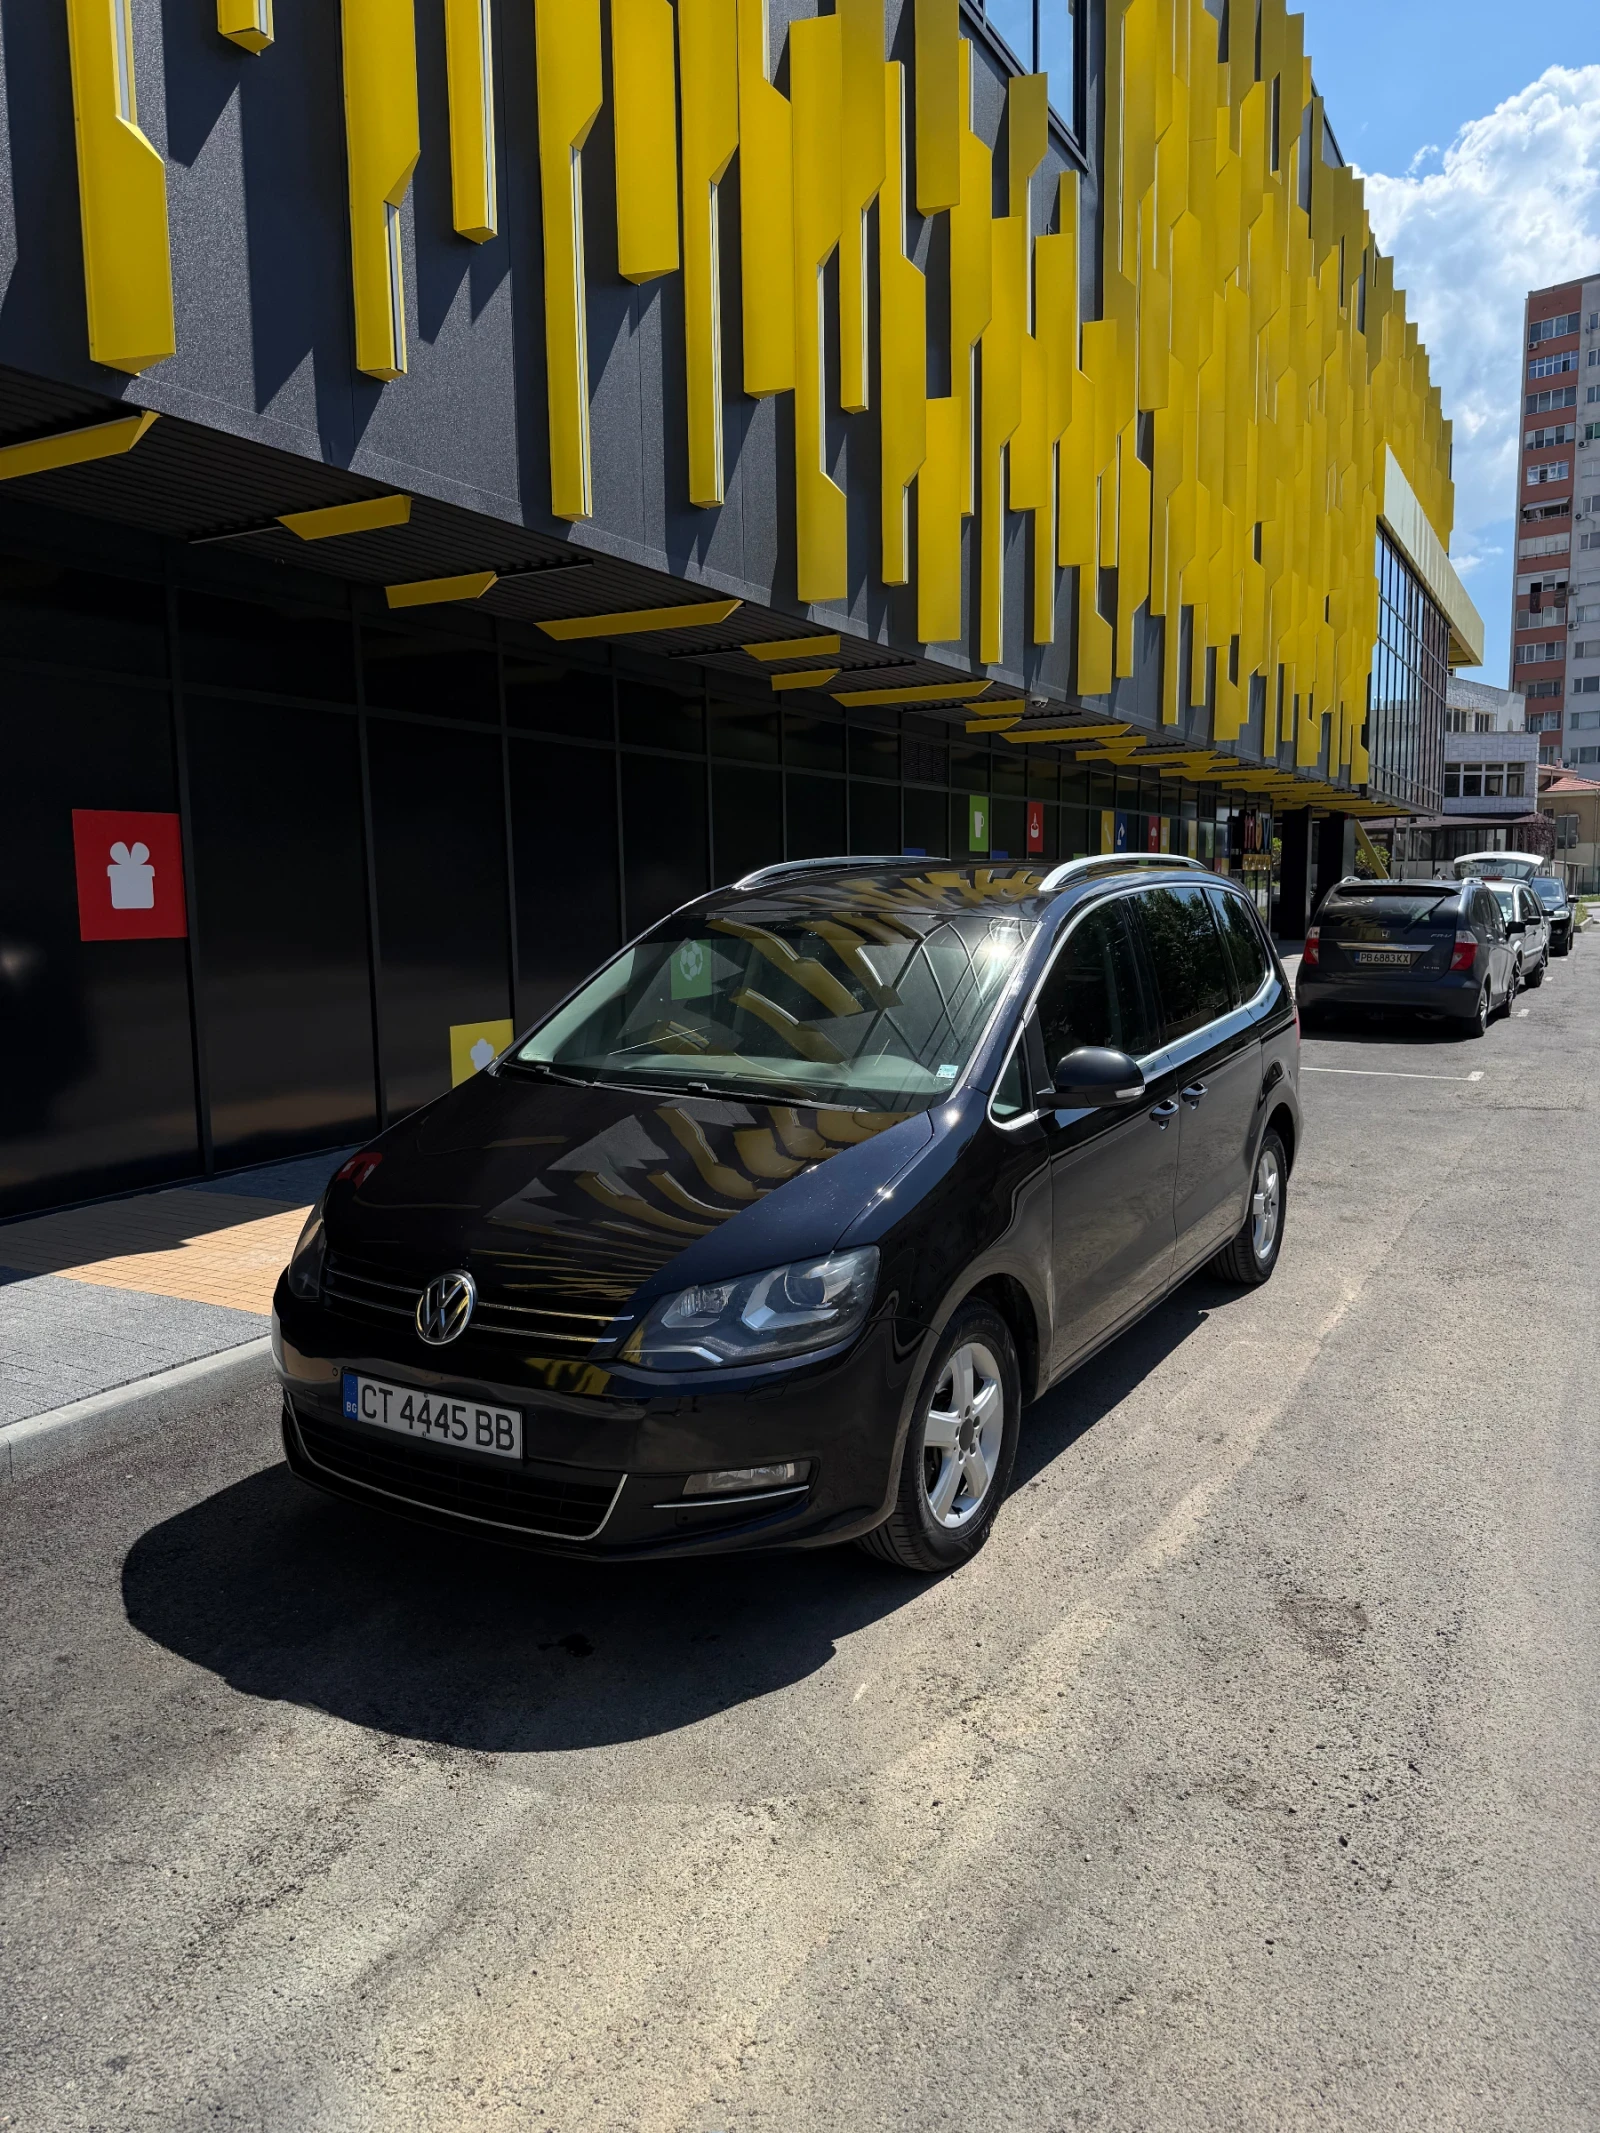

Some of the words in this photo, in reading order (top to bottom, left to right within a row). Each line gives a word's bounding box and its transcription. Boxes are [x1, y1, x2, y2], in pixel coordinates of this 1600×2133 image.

[346, 1401, 358, 1414] BG
[361, 1384, 393, 1423] CT
[400, 1395, 468, 1442] 4445
[475, 1409, 515, 1451] BB
